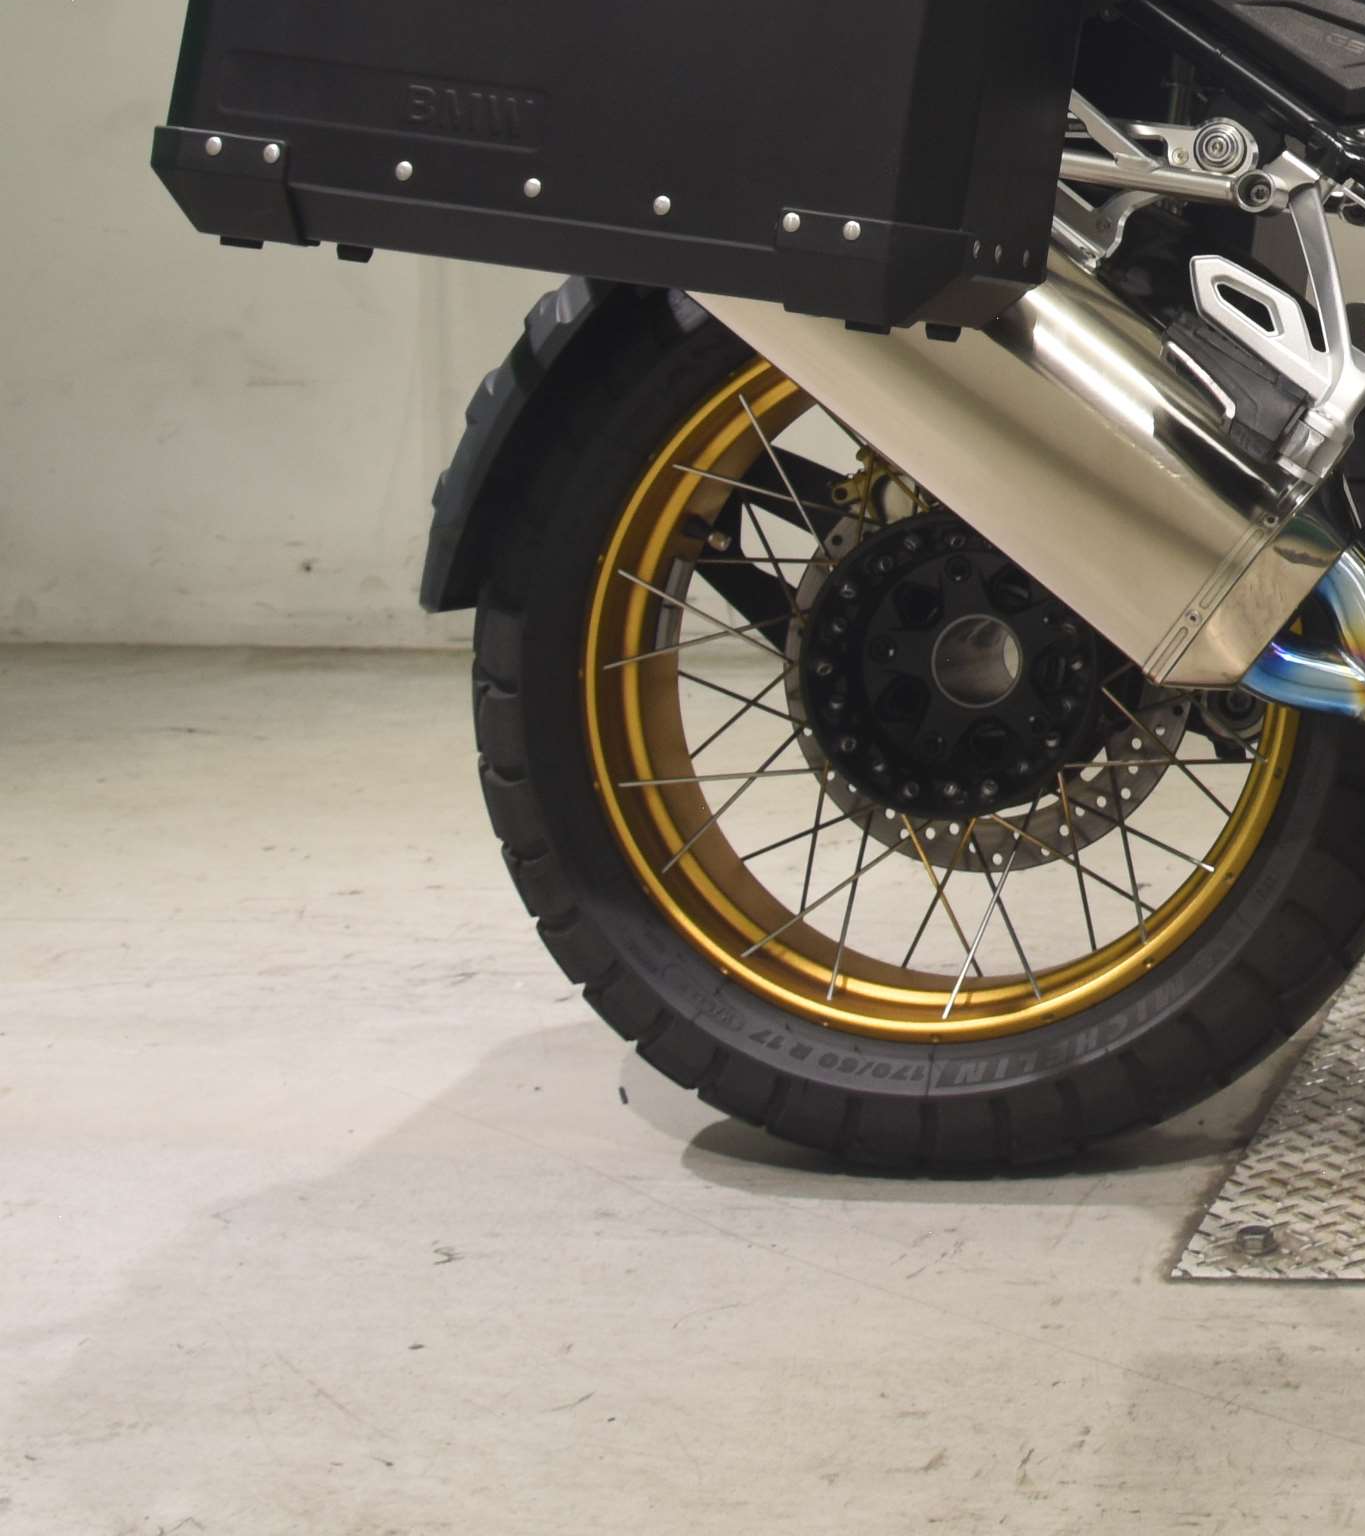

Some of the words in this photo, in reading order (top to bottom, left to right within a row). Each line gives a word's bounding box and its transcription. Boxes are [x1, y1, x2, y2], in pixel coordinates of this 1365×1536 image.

[408, 80, 536, 130] BMW
[748, 1028, 785, 1052] 17
[953, 975, 1186, 1084] MICHELIN
[788, 1042, 813, 1062] R
